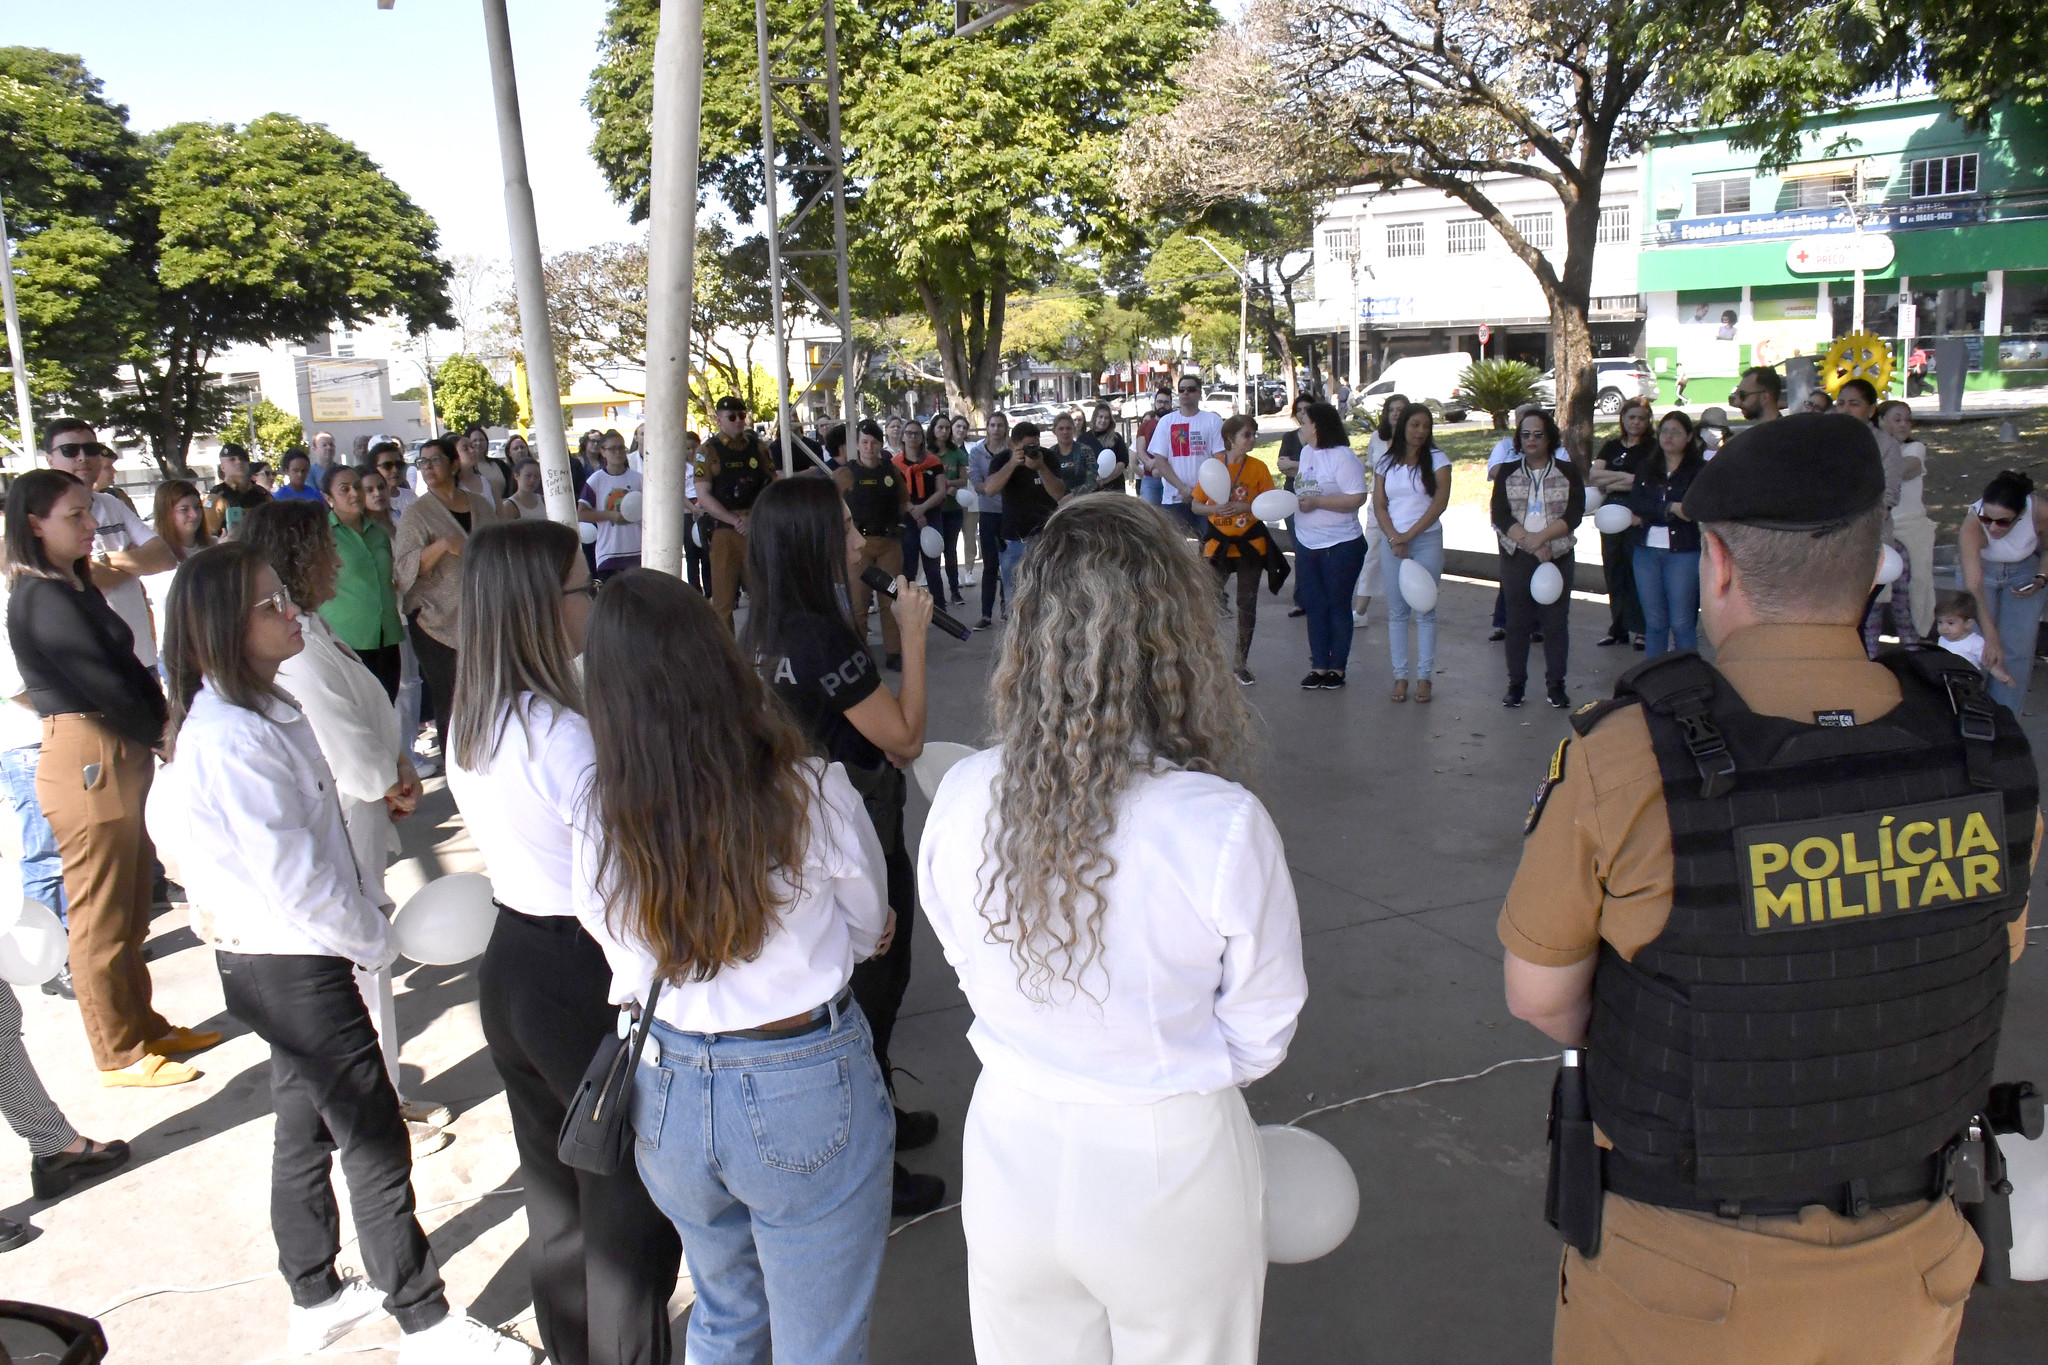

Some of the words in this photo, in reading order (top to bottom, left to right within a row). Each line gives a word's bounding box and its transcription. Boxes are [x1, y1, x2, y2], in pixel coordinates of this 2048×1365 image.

[818, 650, 870, 697] PCP
[1749, 812, 2000, 887] POLÍCIA
[1753, 853, 2002, 929] MILITAR
